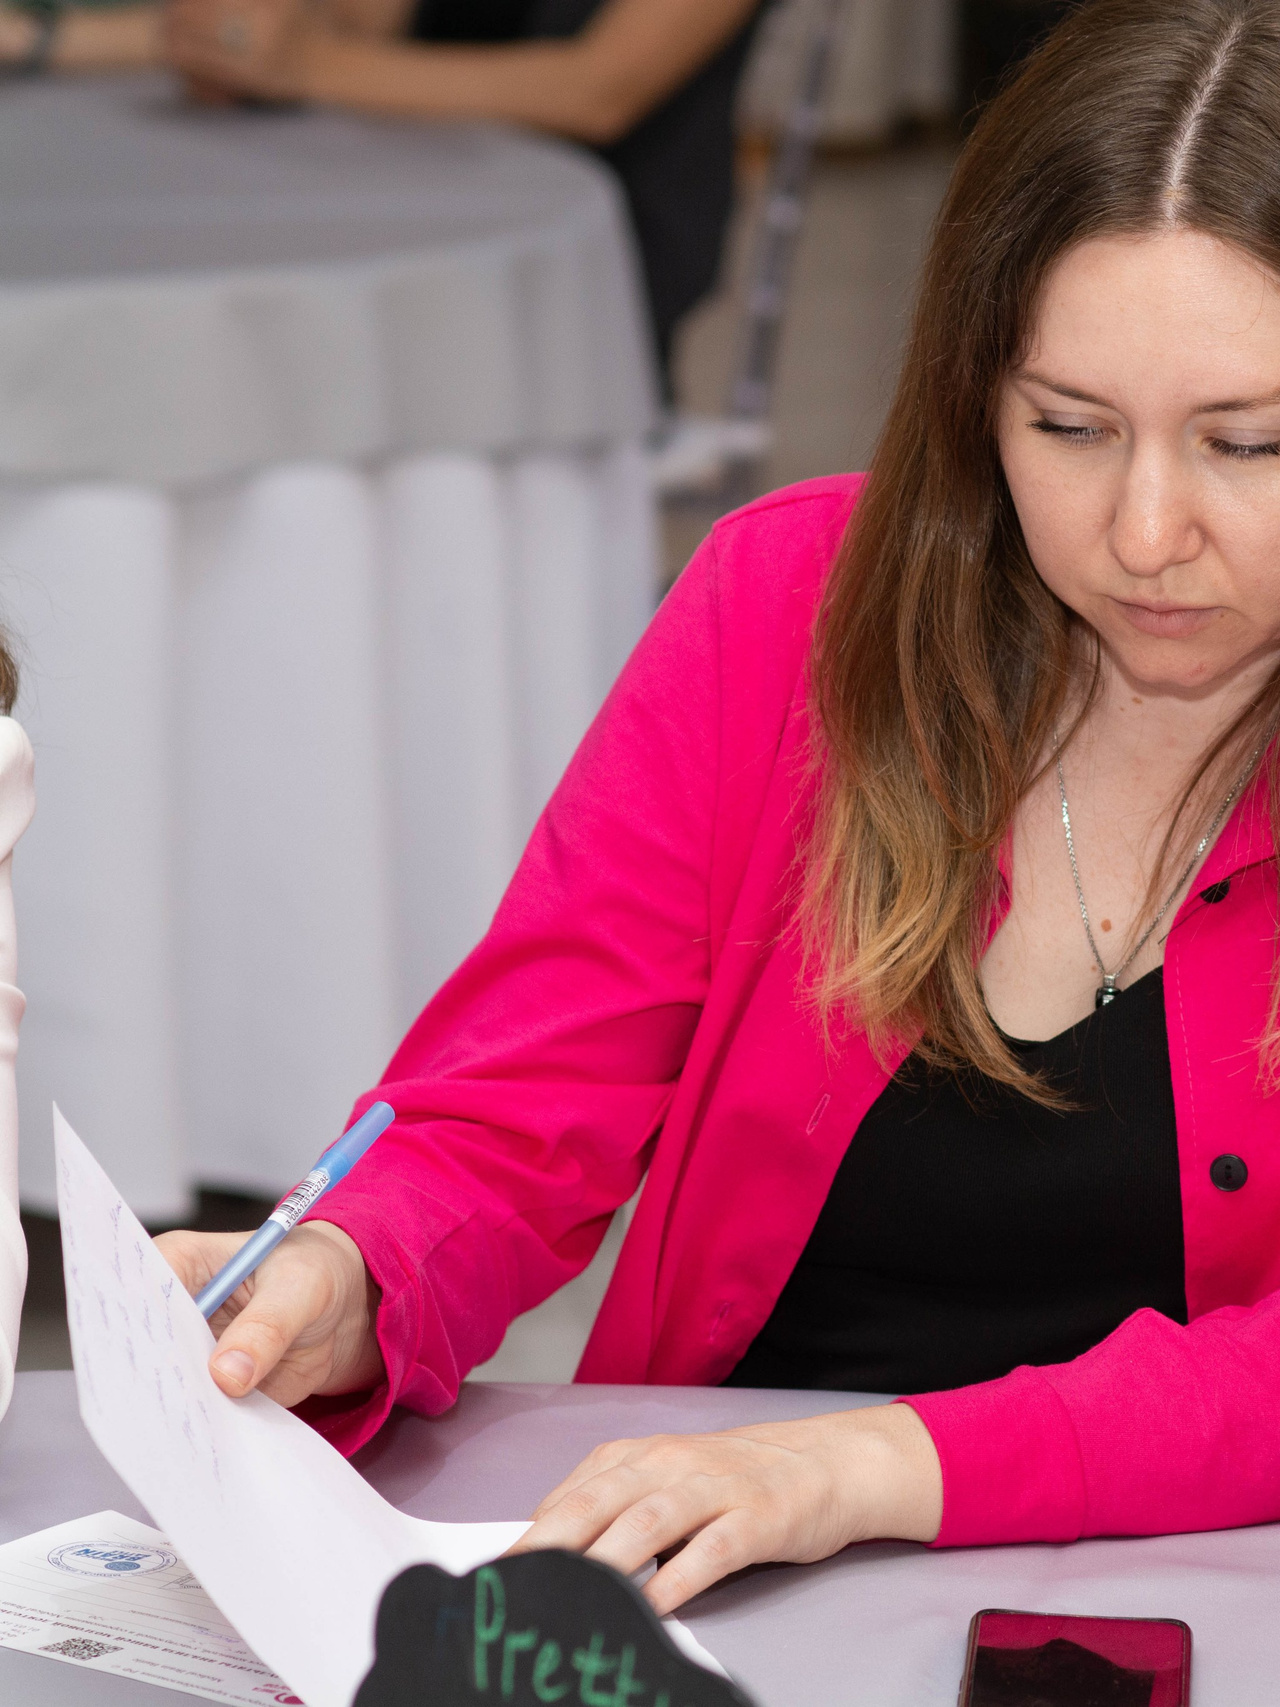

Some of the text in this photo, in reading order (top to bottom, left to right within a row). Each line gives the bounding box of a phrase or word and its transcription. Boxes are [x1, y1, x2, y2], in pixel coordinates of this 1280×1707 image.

[285, 1219, 292, 1228] 3
[290, 1196, 311, 1221] 086123
[74, 1548, 141, 1561] BRAIN
[473, 1564, 670, 1707] Prett
